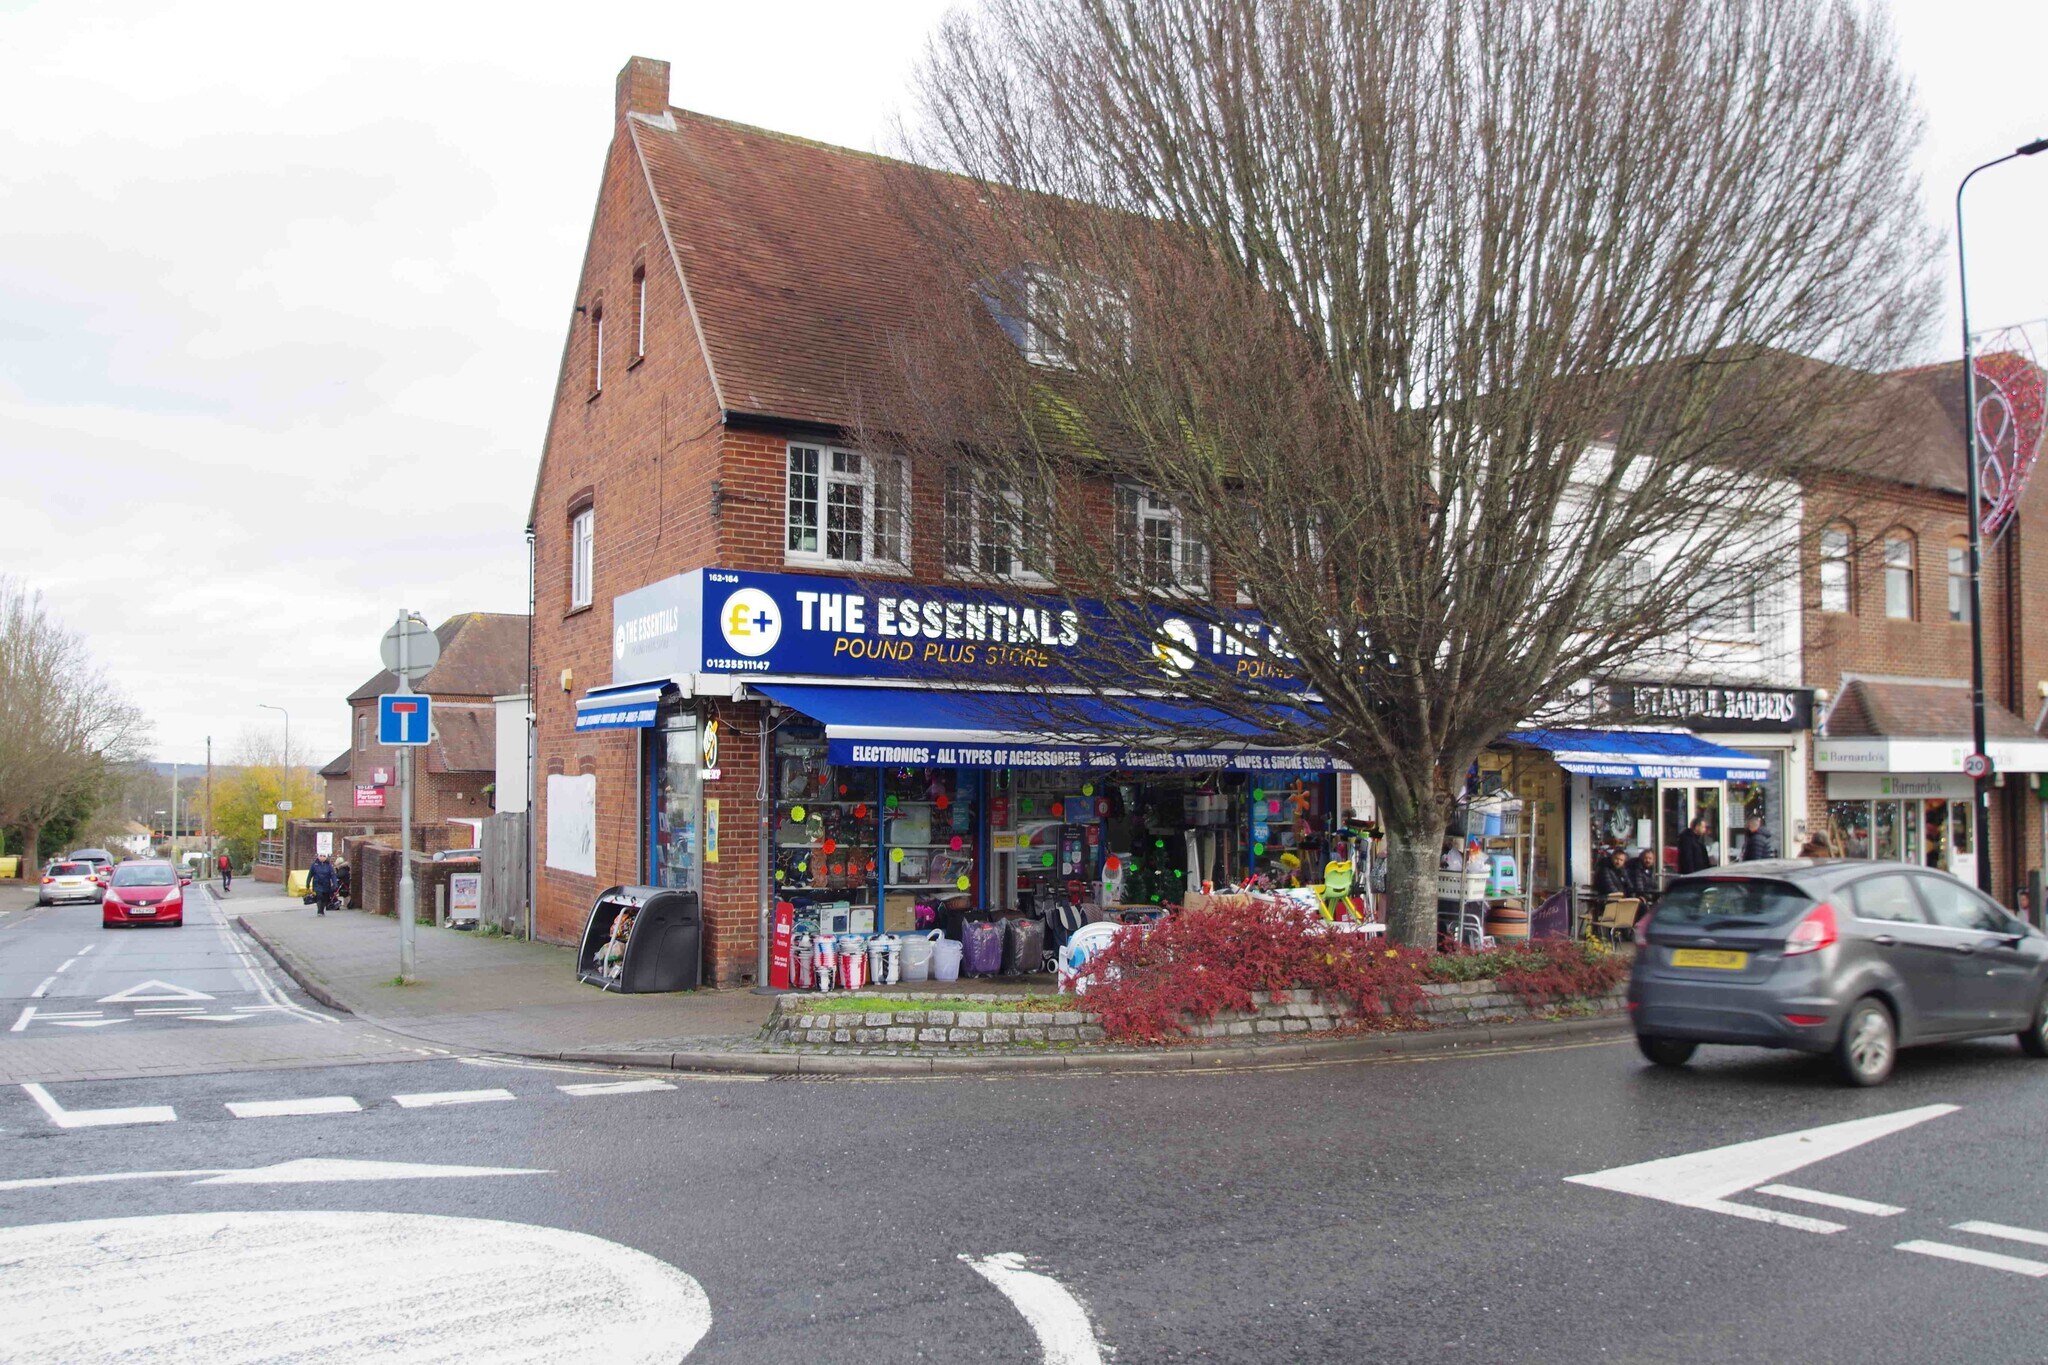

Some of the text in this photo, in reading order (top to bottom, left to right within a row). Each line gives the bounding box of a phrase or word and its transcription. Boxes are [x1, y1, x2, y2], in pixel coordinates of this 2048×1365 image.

[625, 605, 679, 644] THE ESSENTIALS
[796, 591, 1078, 647] THE ESSENTIALS
[834, 638, 1048, 668] POUND PLUS STORE
[706, 659, 770, 671] 01235511147
[1633, 686, 1796, 722] ISTANBUL BARBERS
[853, 745, 929, 764] ELECTRONICS
[937, 748, 956, 764] ALL
[958, 749, 991, 766] TYPES
[994, 749, 1008, 766] OF
[1008, 750, 1081, 767] ACCESSORIES
[1176, 755, 1185, 768] &
[1234, 755, 1262, 769] VAPES
[1263, 757, 1271, 769] &
[1271, 756, 1303, 769] SMOKE
[1830, 751, 1884, 763] Barnardo's
[1966, 760, 1984, 771] 20
[1638, 765, 1700, 779] WRAP N SHAKE
[1892, 777, 1942, 794] Barnardo's
